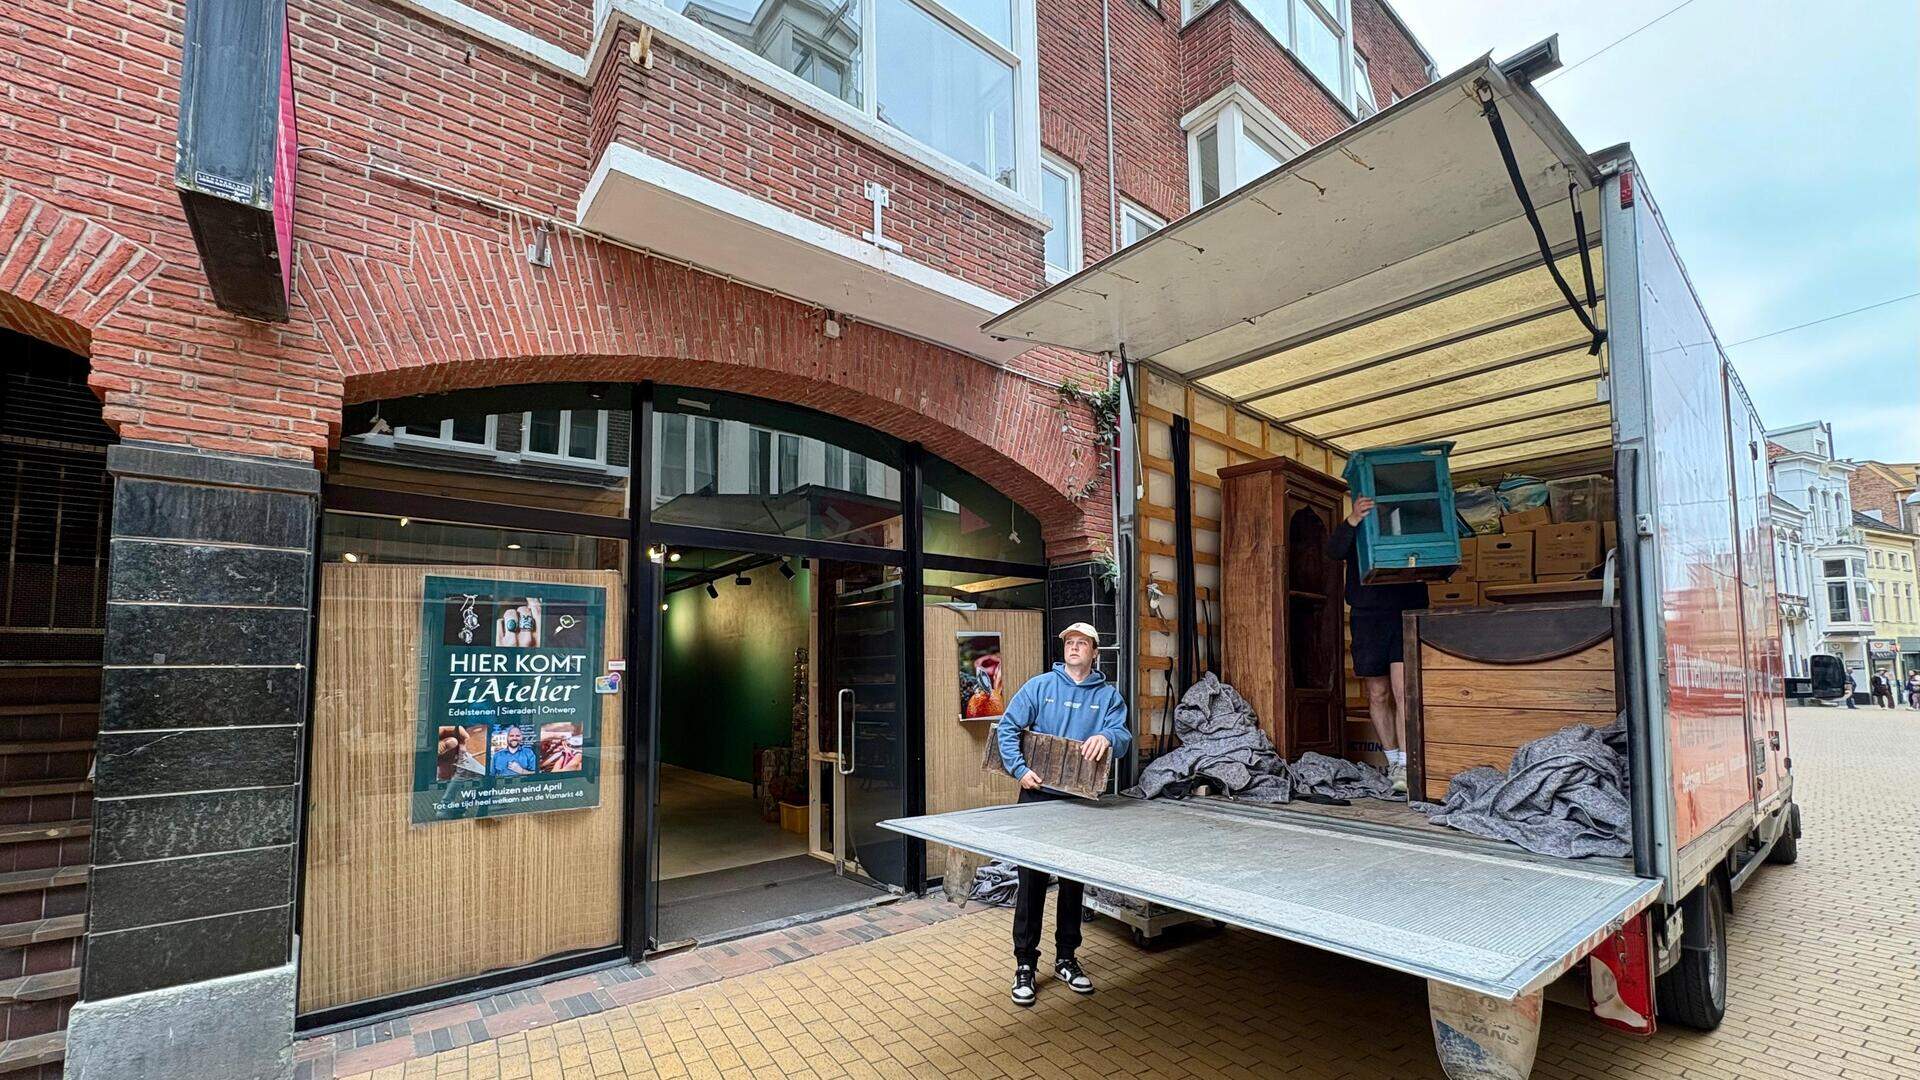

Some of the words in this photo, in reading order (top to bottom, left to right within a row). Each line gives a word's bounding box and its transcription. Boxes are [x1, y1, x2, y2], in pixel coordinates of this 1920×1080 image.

[450, 653, 508, 672] HIER
[515, 654, 587, 672] KOMT
[448, 675, 581, 703] LiAtelier
[448, 708, 496, 717] Edelstenen
[502, 706, 537, 715] Sieraden
[541, 705, 576, 715] Ontwerp
[460, 789, 477, 799] Wij
[478, 787, 521, 797] verhuizen
[522, 784, 541, 793] eind
[542, 782, 562, 793] April
[447, 800, 460, 808] die
[461, 799, 474, 809] tijd
[475, 797, 492, 806] heel
[492, 796, 520, 805] welkom
[535, 793, 544, 801] de
[545, 791, 574, 800] Vismarkt
